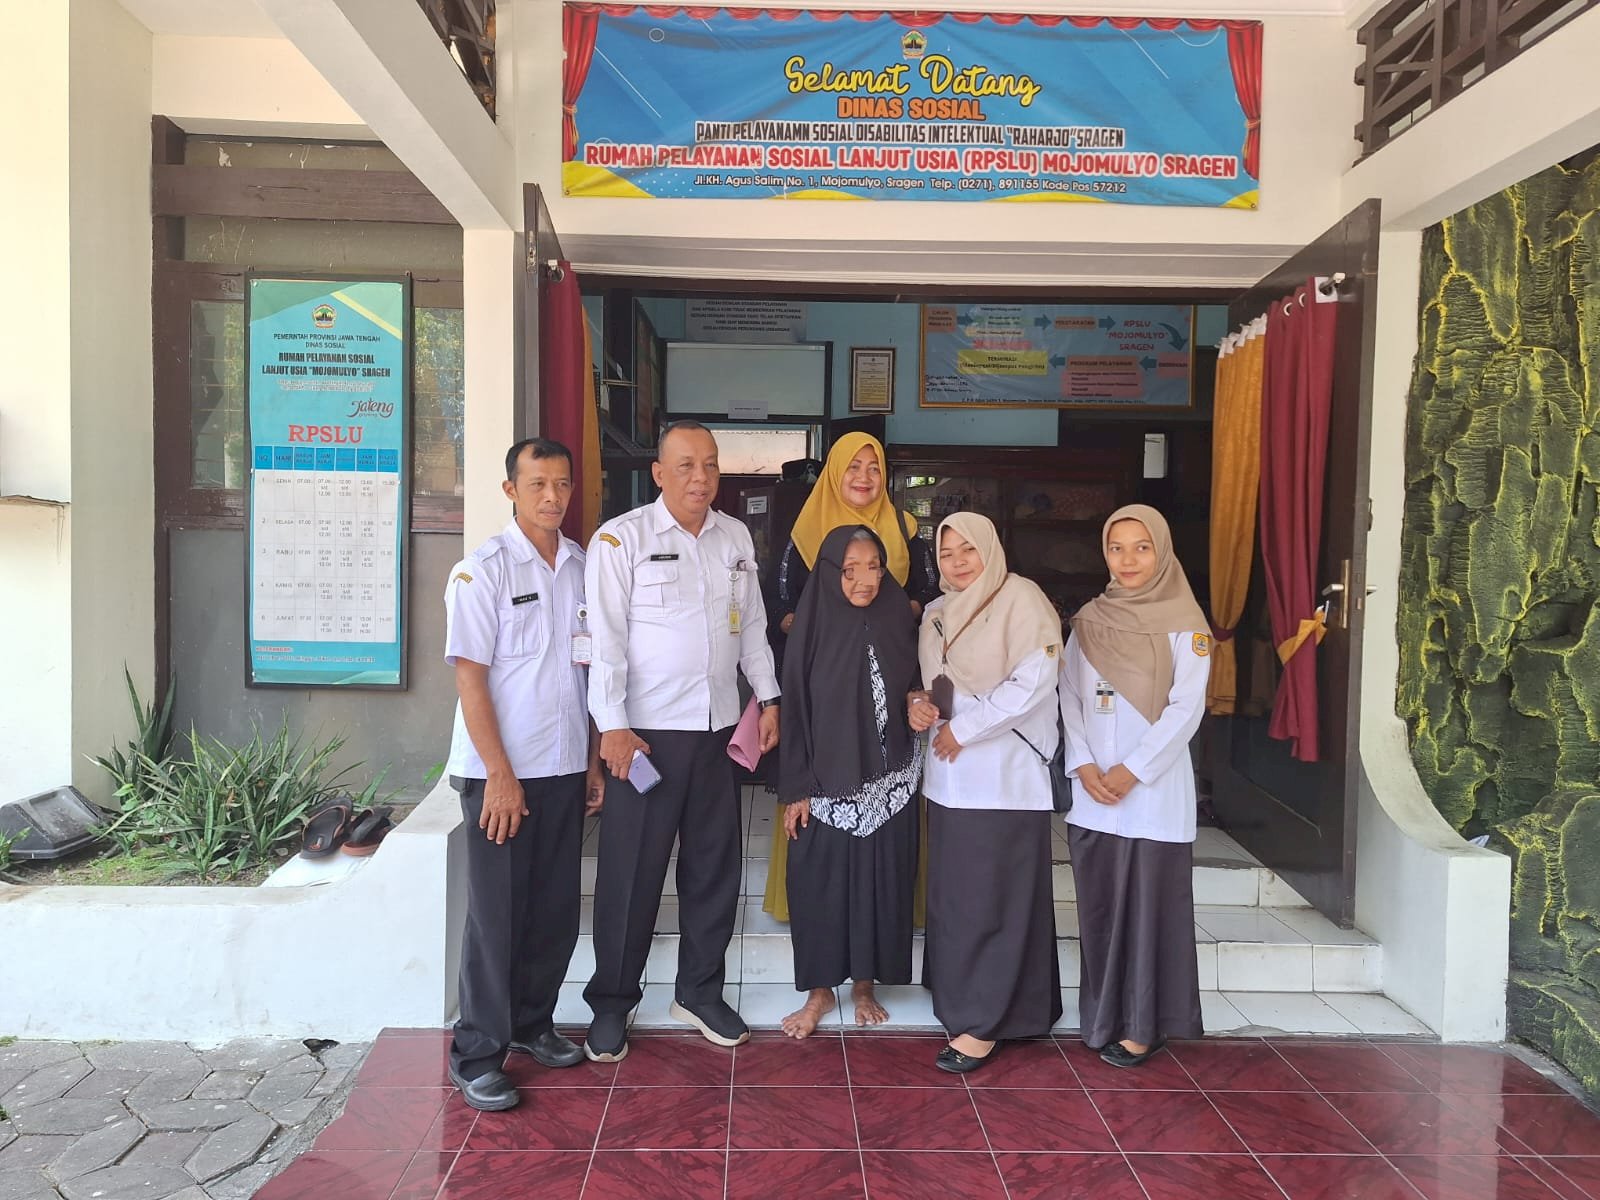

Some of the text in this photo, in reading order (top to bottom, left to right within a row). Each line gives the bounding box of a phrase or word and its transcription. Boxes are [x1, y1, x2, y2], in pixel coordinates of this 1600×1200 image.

[784, 54, 1042, 107] Selamat Datang
[837, 97, 986, 121] DINAS SOSIAL
[696, 122, 731, 141] PANTI
[733, 121, 810, 142] PELAYANAMN
[812, 122, 853, 142] SOSIAL
[856, 123, 925, 143] DISABILITAS
[928, 124, 1003, 145] INTELEKTUAL
[586, 145, 1236, 177] RUMAH PELAYANAN SOSIAL LANJUT USIA (RPSLU) MOJOMULYO SRAGEN
[725, 176, 751, 187] Agus
[754, 176, 783, 186] Salim
[786, 177, 804, 187] No.
[821, 177, 884, 189] Mojomulyo,
[887, 178, 924, 190] Sragen
[930, 178, 955, 190] Telp.
[999, 179, 1040, 190] 891155
[1042, 180, 1069, 191] Kode
[1072, 182, 1090, 192] Pos
[1092, 182, 1127, 193] 57212
[279, 352, 375, 364] RUMAH PELAYANAN SOSIAL
[262, 364, 289, 375] LANJUT
[290, 365, 307, 375] USIA
[362, 367, 391, 377] SRAGEN
[287, 424, 363, 444] RPSLU
